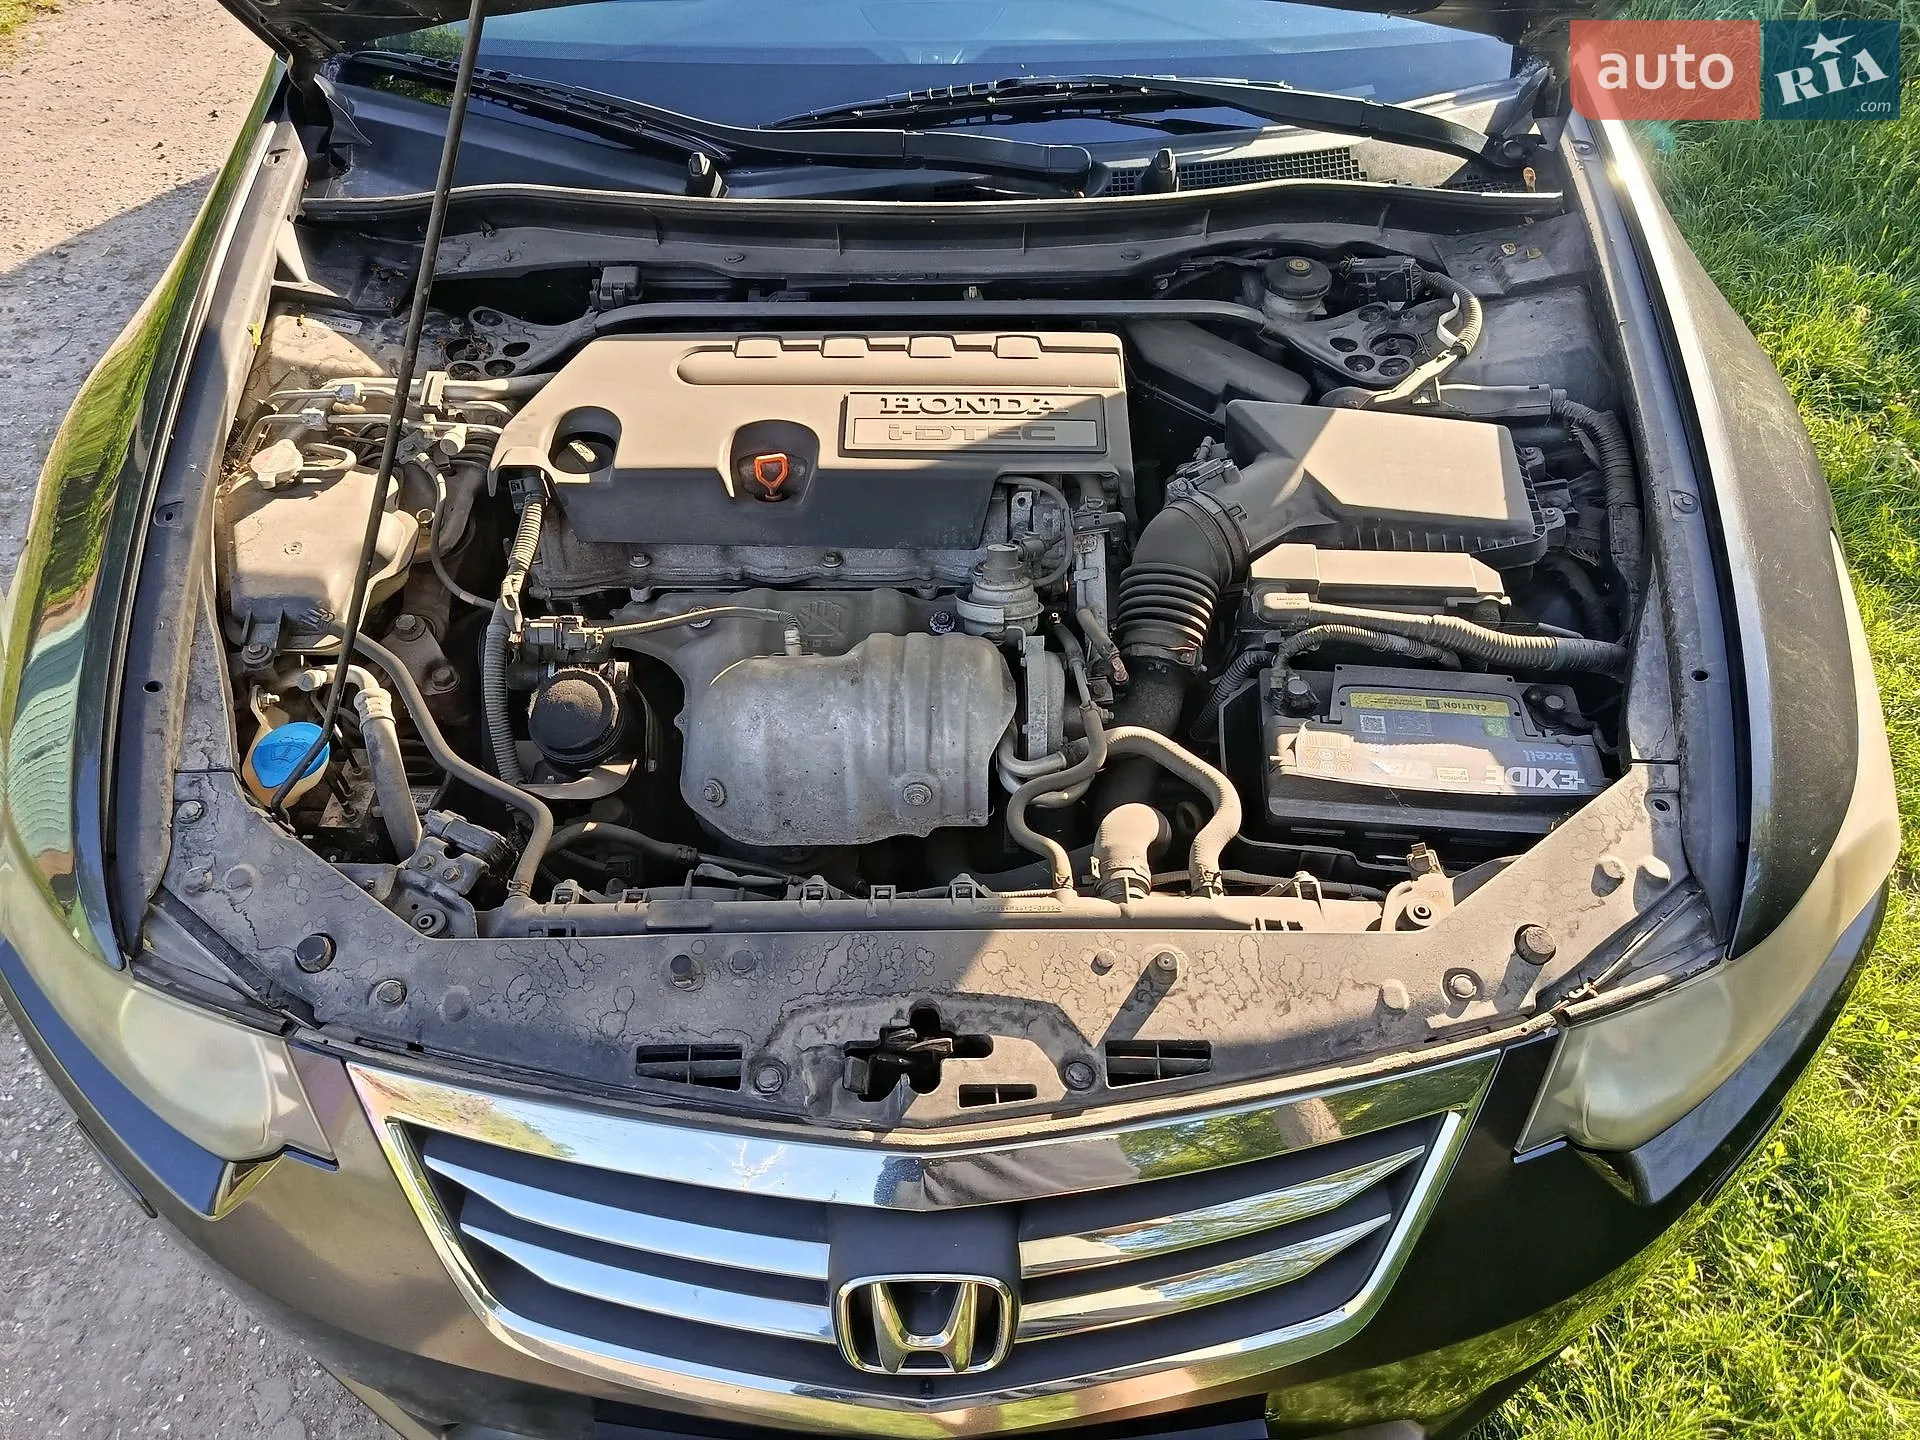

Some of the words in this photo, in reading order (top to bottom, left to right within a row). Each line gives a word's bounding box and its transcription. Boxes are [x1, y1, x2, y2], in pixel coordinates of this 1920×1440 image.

[879, 395, 1070, 416] HONDA
[888, 423, 1056, 441] i-DTEC
[1443, 701, 1487, 712] CAUTION
[1522, 749, 1577, 765] Excell
[1484, 766, 1585, 790] EXIDE
